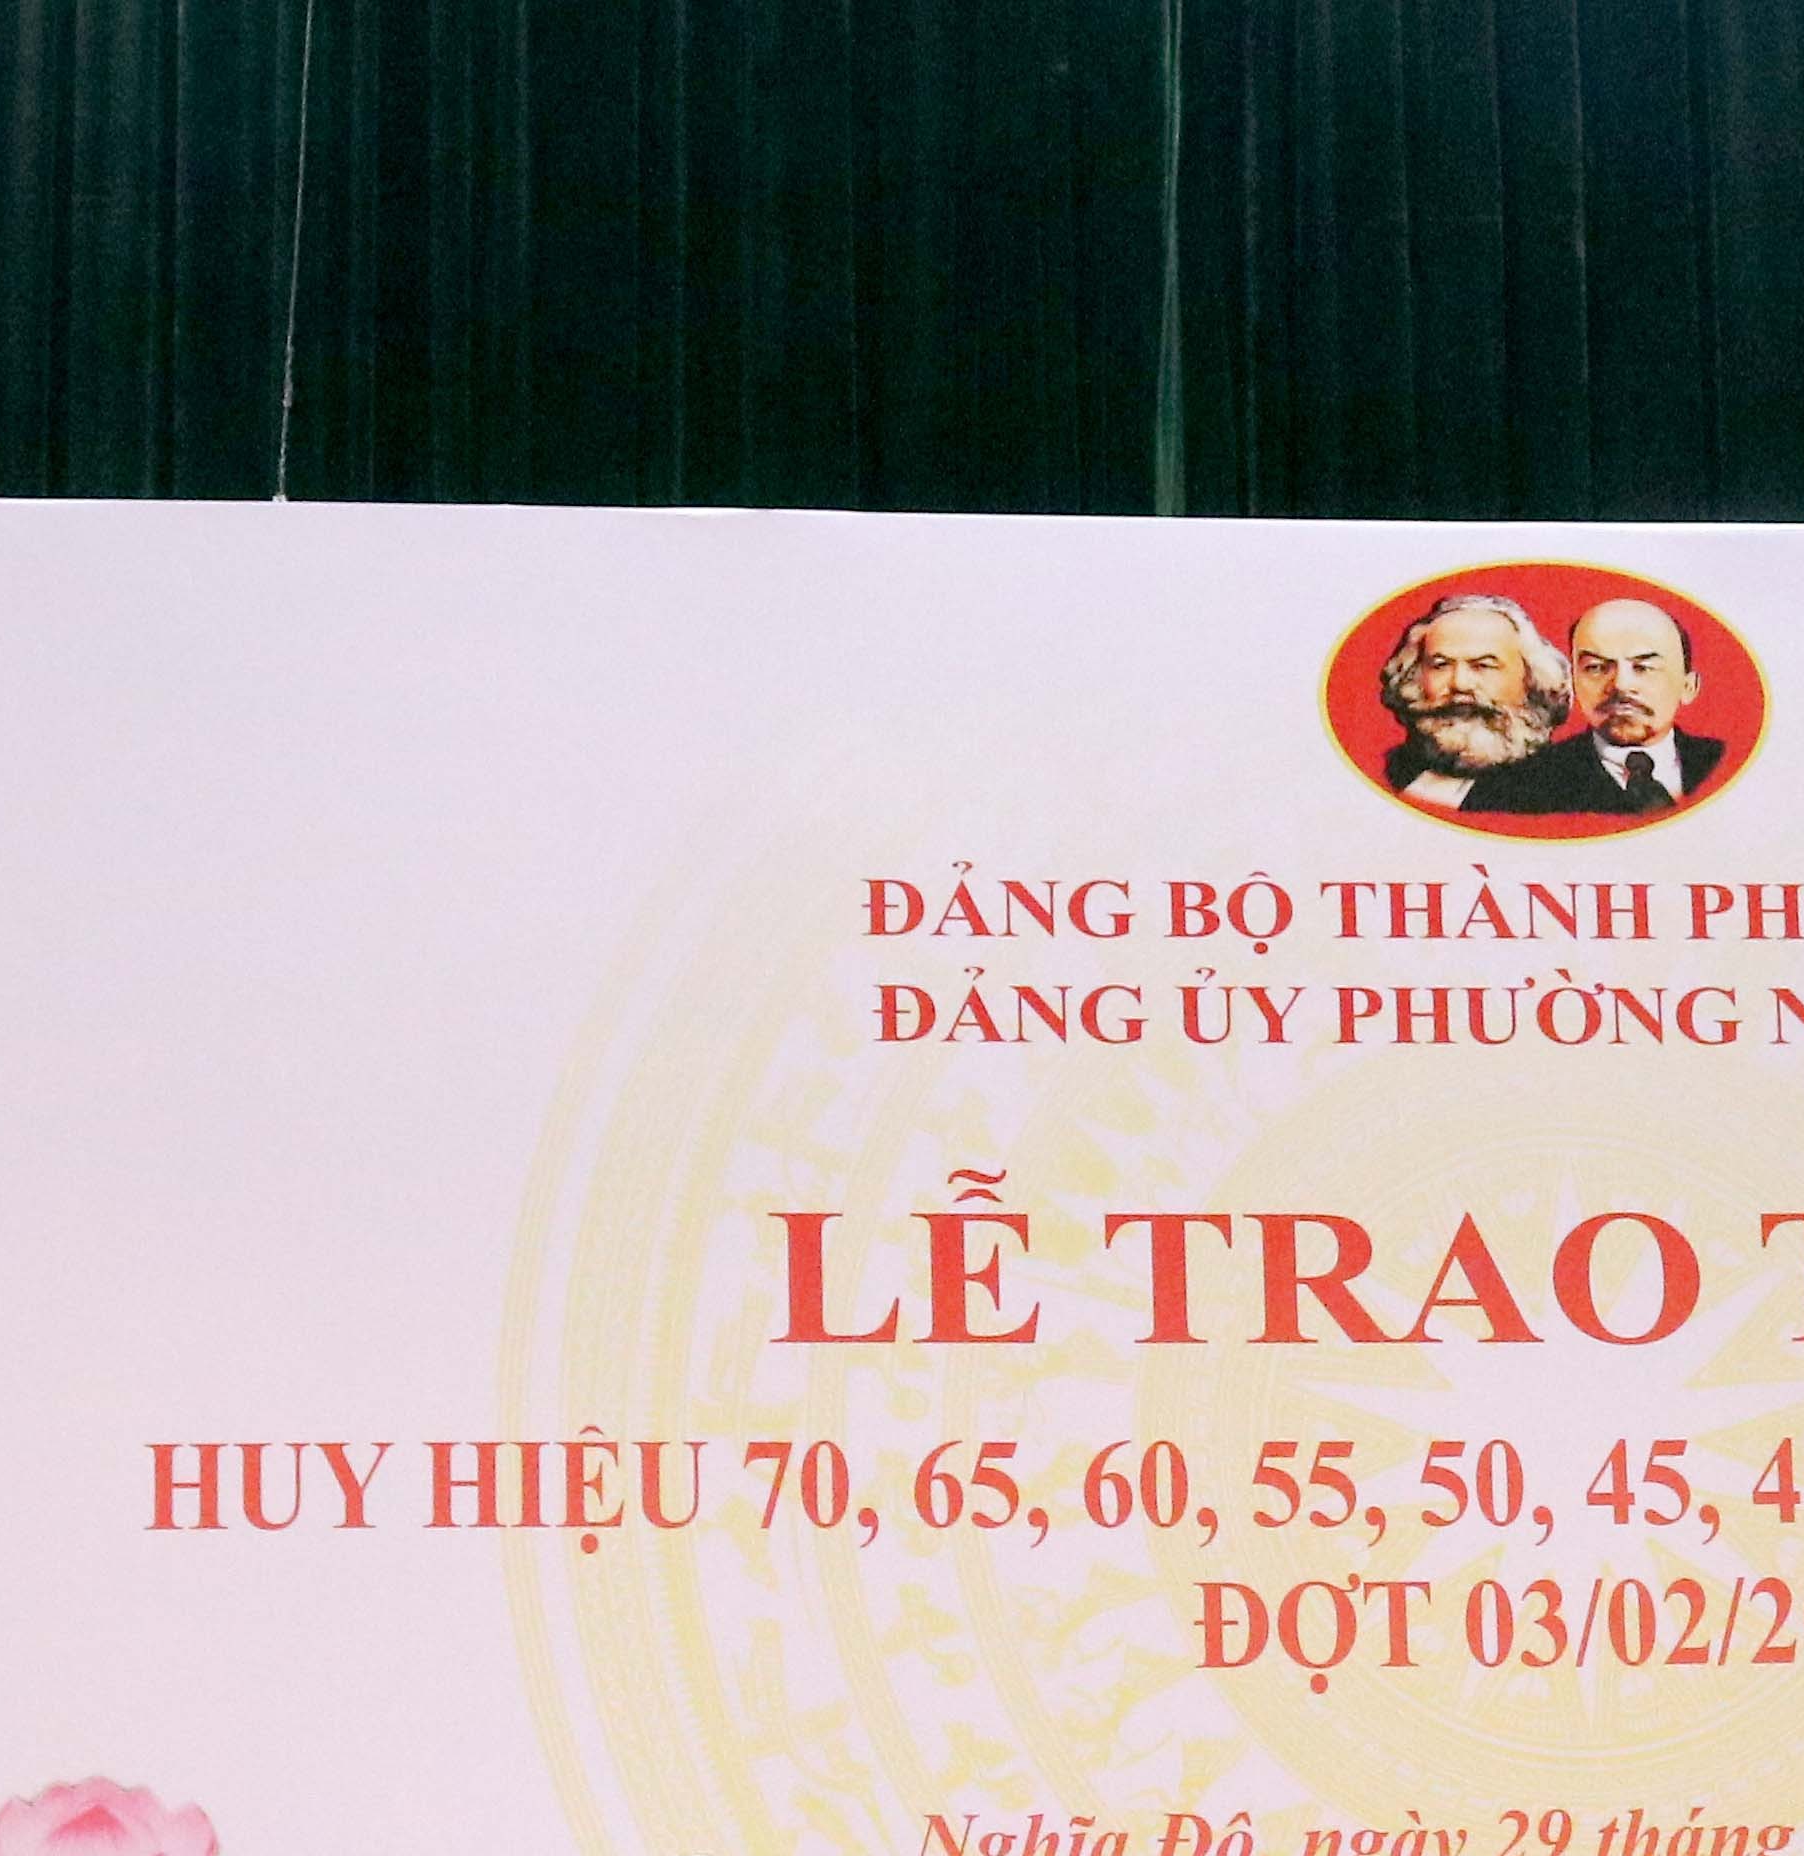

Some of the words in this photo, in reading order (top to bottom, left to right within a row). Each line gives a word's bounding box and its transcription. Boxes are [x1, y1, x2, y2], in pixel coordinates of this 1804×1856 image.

[864, 862, 1136, 939] ĐẢNG
[1166, 870, 1297, 956] BỘ
[1316, 862, 1655, 940] THÀNH
[874, 966, 1148, 1044] ĐẢNG
[1178, 967, 1306, 1045] ỦY
[1333, 967, 1742, 1045] PHƯỜNG
[768, 1167, 1043, 1344] LỄ
[1101, 1210, 1704, 1346] TRAO
[148, 1441, 393, 1531] HUY
[426, 1424, 708, 1554] HIỆU
[741, 1439, 883, 1549] 70,
[911, 1439, 1052, 1547] 65,
[1080, 1439, 1222, 1545] 60,
[1249, 1439, 1390, 1547] 55,
[1418, 1438, 1557, 1541] 50,
[1583, 1437, 1724, 1543] 45,
[1193, 1572, 1434, 1695] ĐỢT
